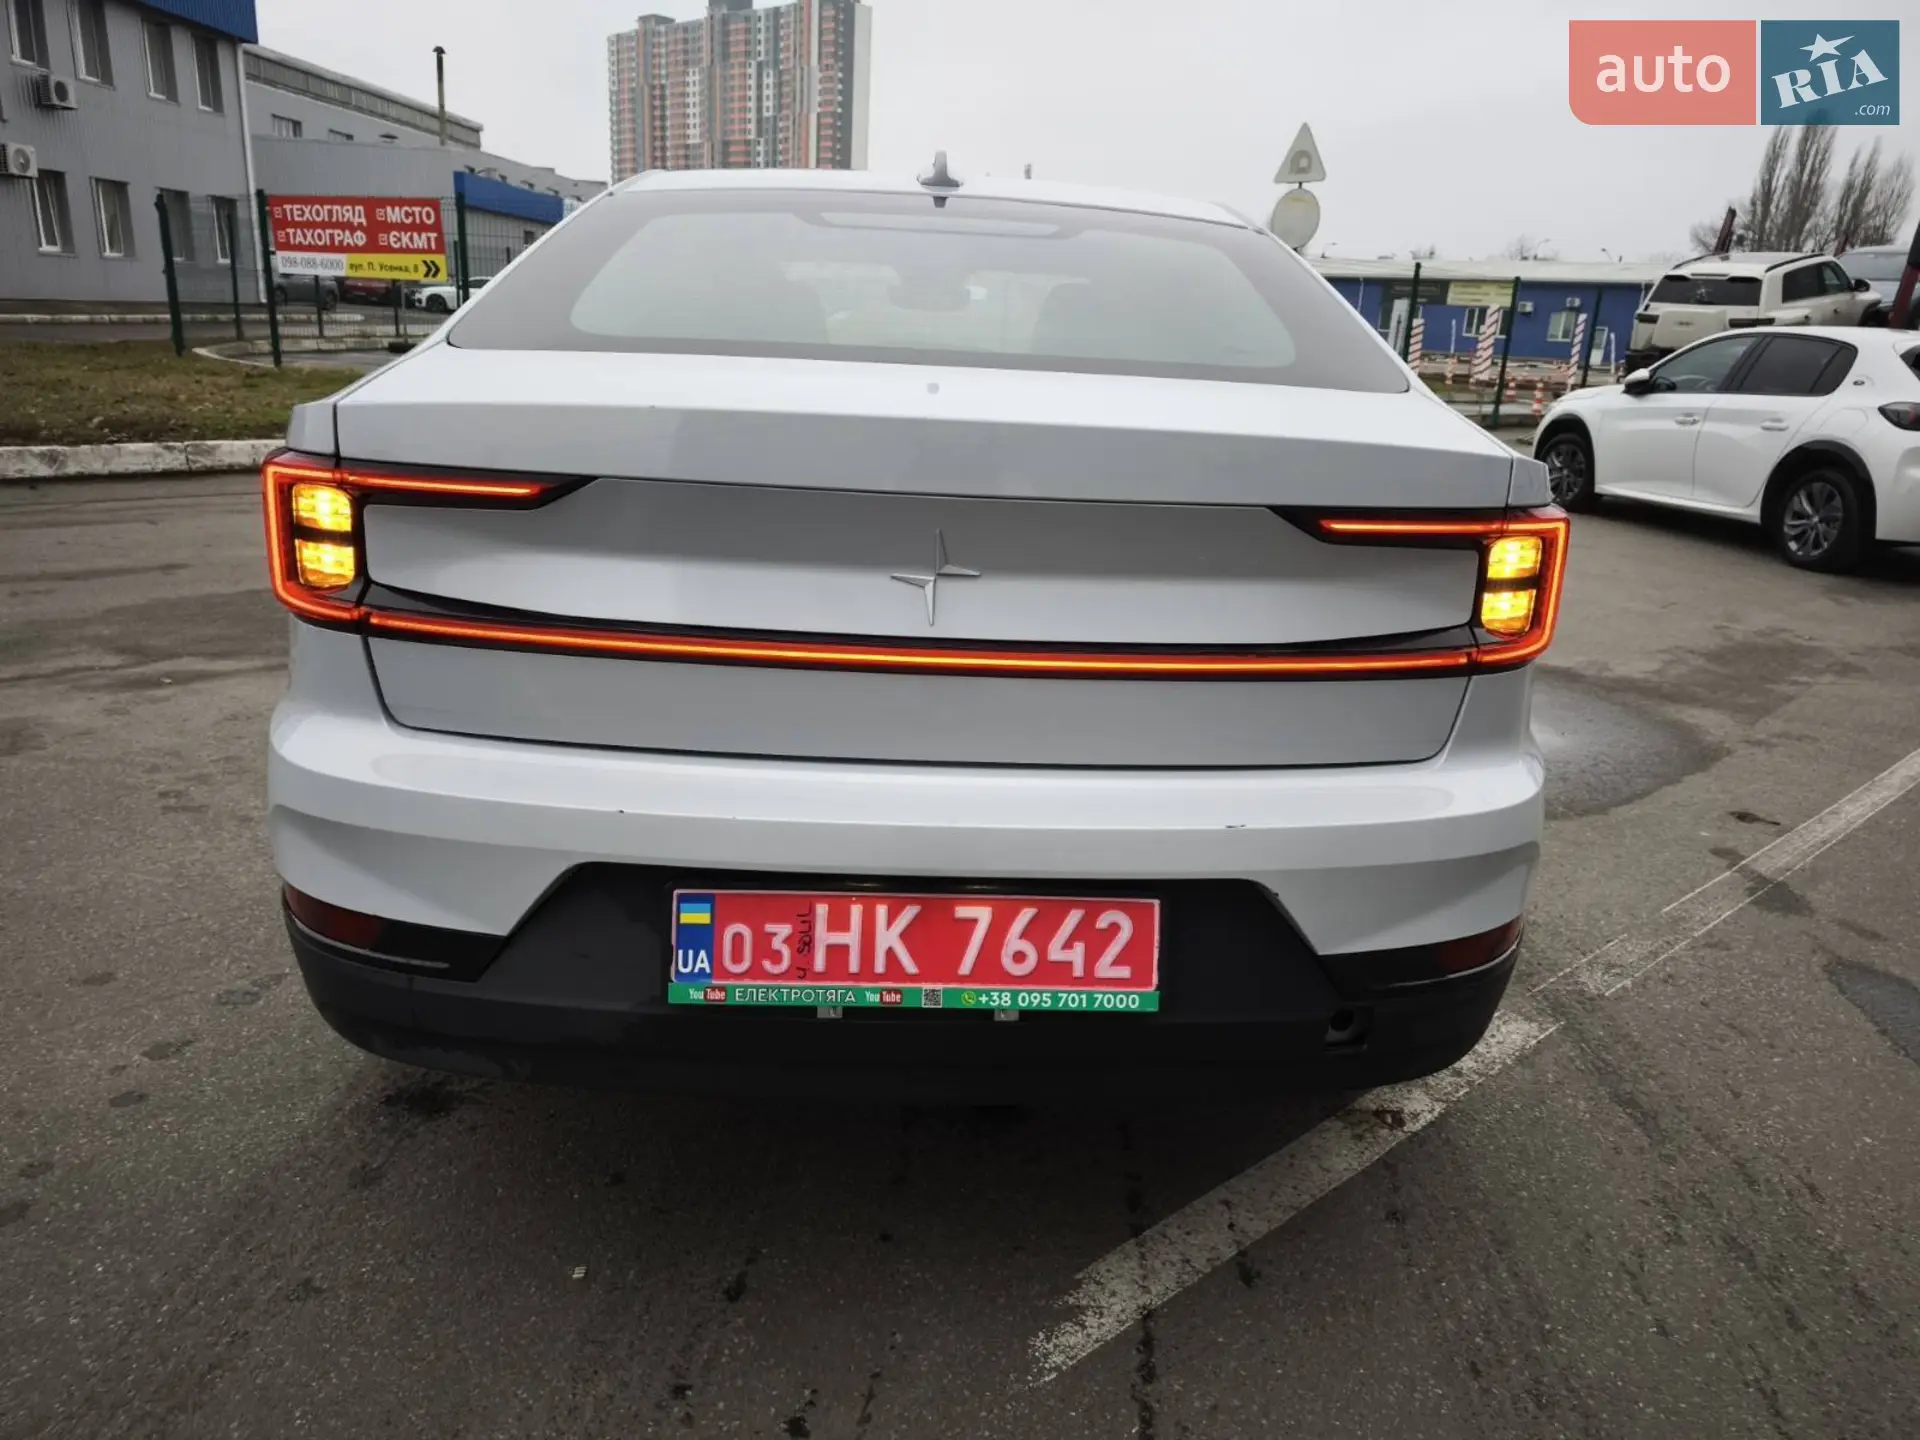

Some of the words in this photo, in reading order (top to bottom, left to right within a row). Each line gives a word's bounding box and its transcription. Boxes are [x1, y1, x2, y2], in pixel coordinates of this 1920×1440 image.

[283, 204, 367, 226] ТЕХОГЛЯД
[386, 207, 435, 225] МСТО
[286, 228, 367, 247] ТАХОГРАФ
[388, 231, 438, 250] ЄКМТ
[721, 923, 792, 976] 03
[813, 903, 921, 975] HK
[954, 906, 1134, 980] 7642
[677, 949, 711, 974] UA
[689, 987, 726, 1001] YouTube
[735, 988, 856, 1003] ЕЛЕКТРОТЯГА
[865, 990, 902, 1004] YouTube
[978, 992, 1011, 1006] +38
[1018, 992, 1052, 1007] 095
[1058, 993, 1087, 1008] 701
[1094, 994, 1139, 1009] 7000
